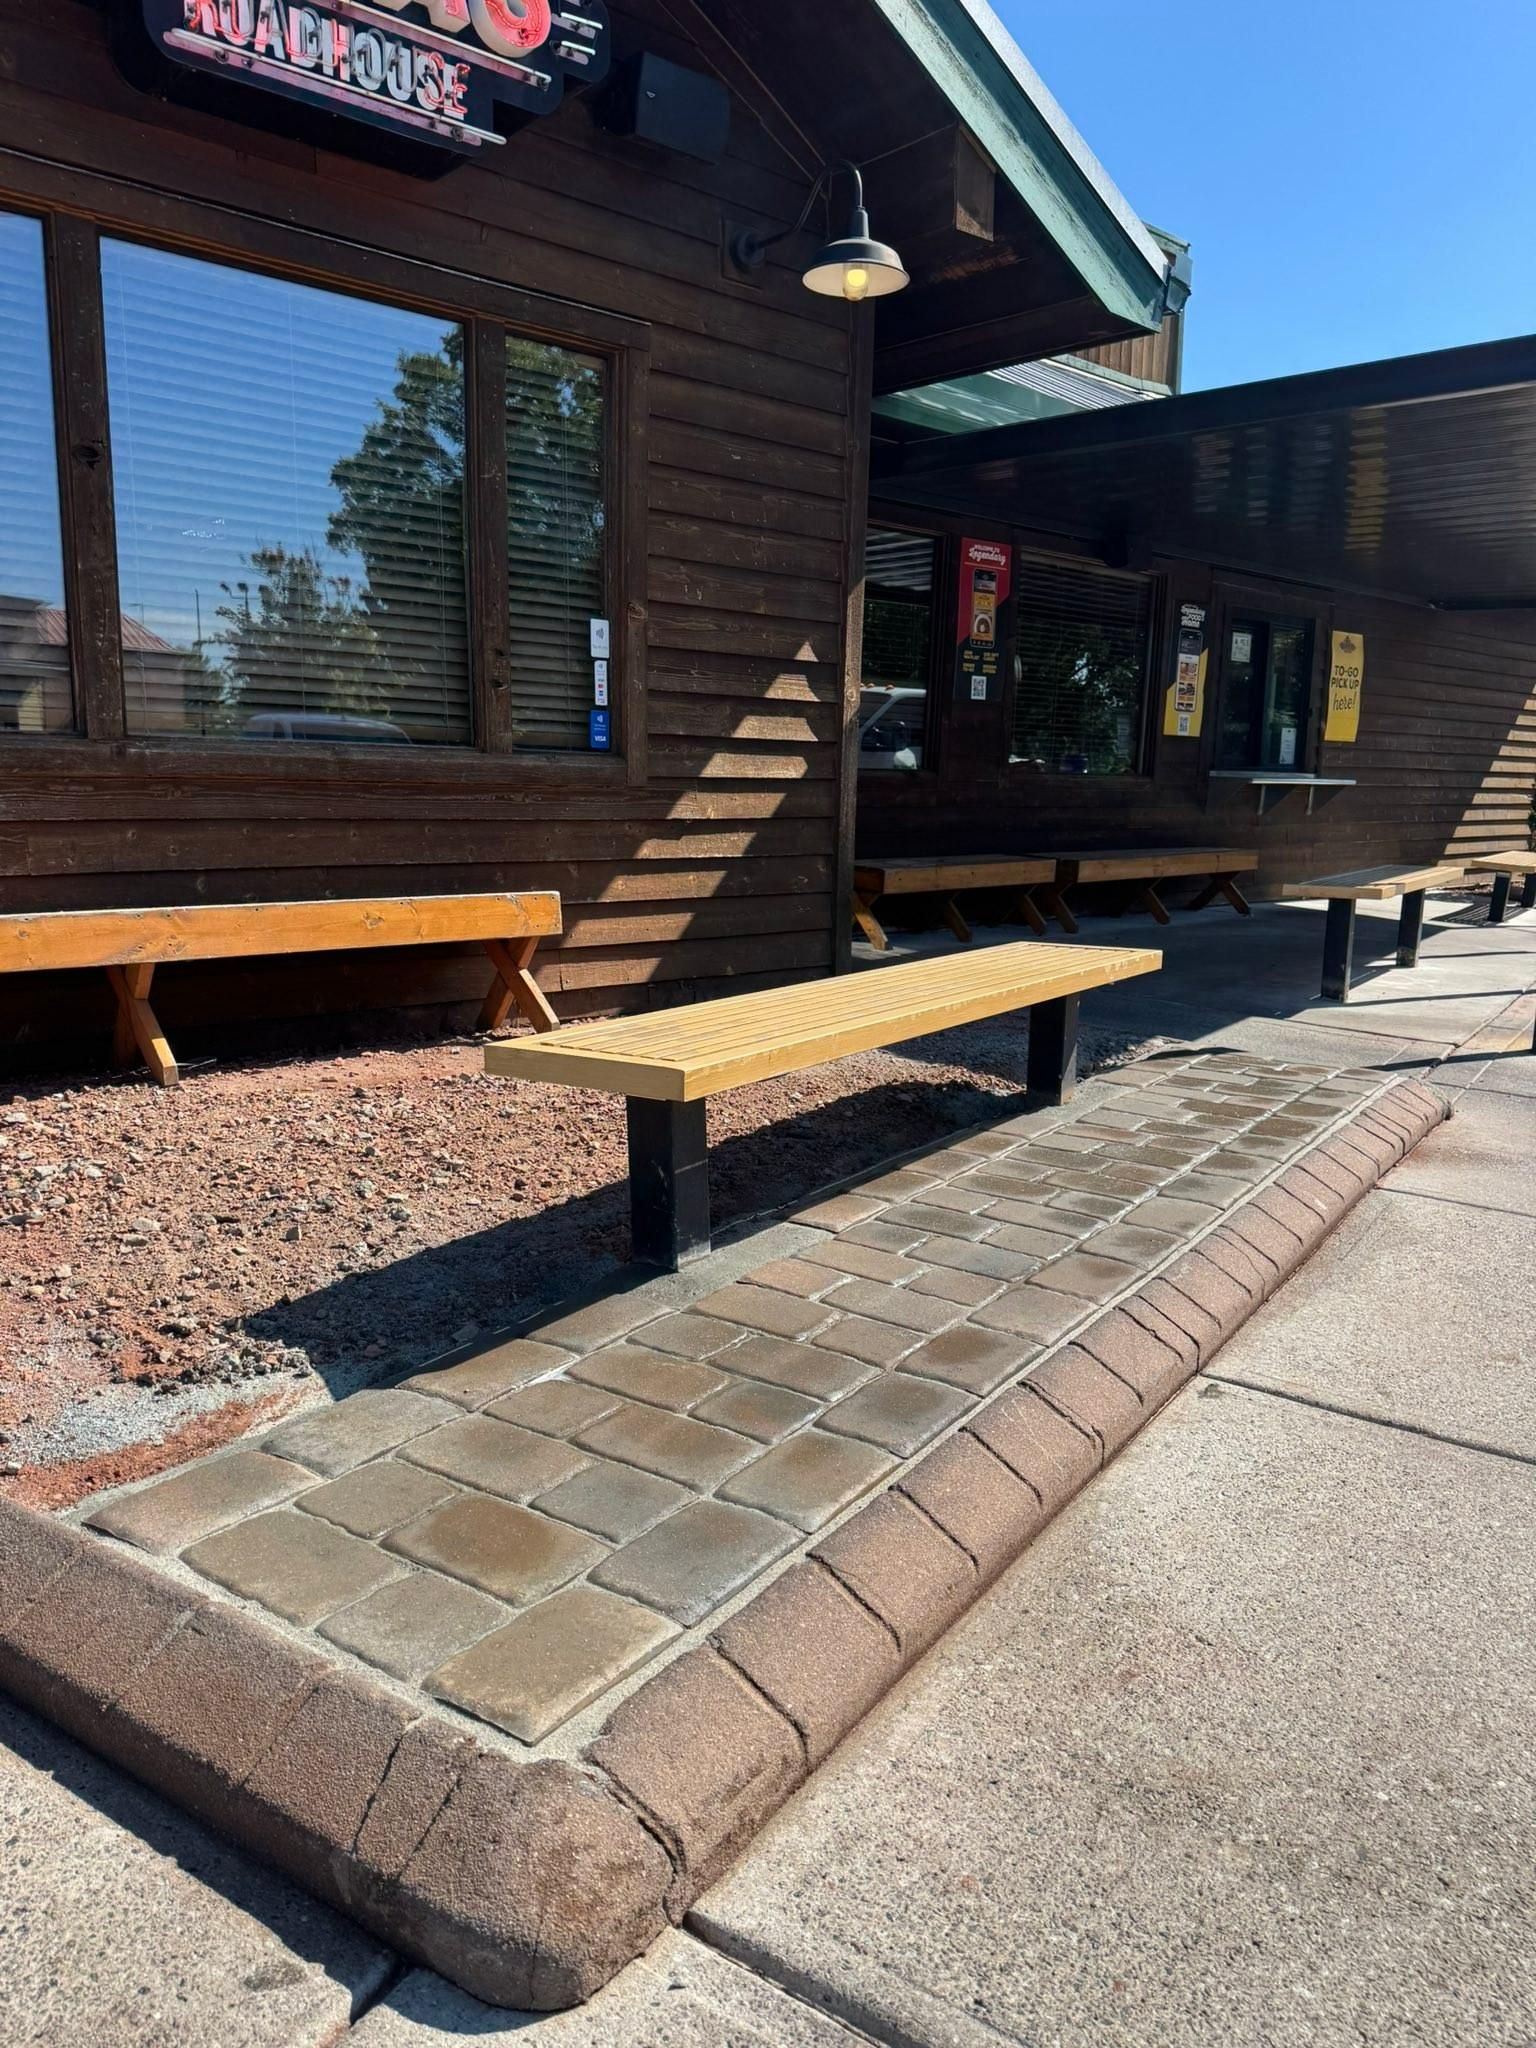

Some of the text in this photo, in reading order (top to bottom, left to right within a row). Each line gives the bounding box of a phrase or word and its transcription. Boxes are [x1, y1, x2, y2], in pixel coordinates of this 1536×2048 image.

[1334, 665, 1359, 678] TO-GO
[1330, 677, 1360, 690] PICK UP
